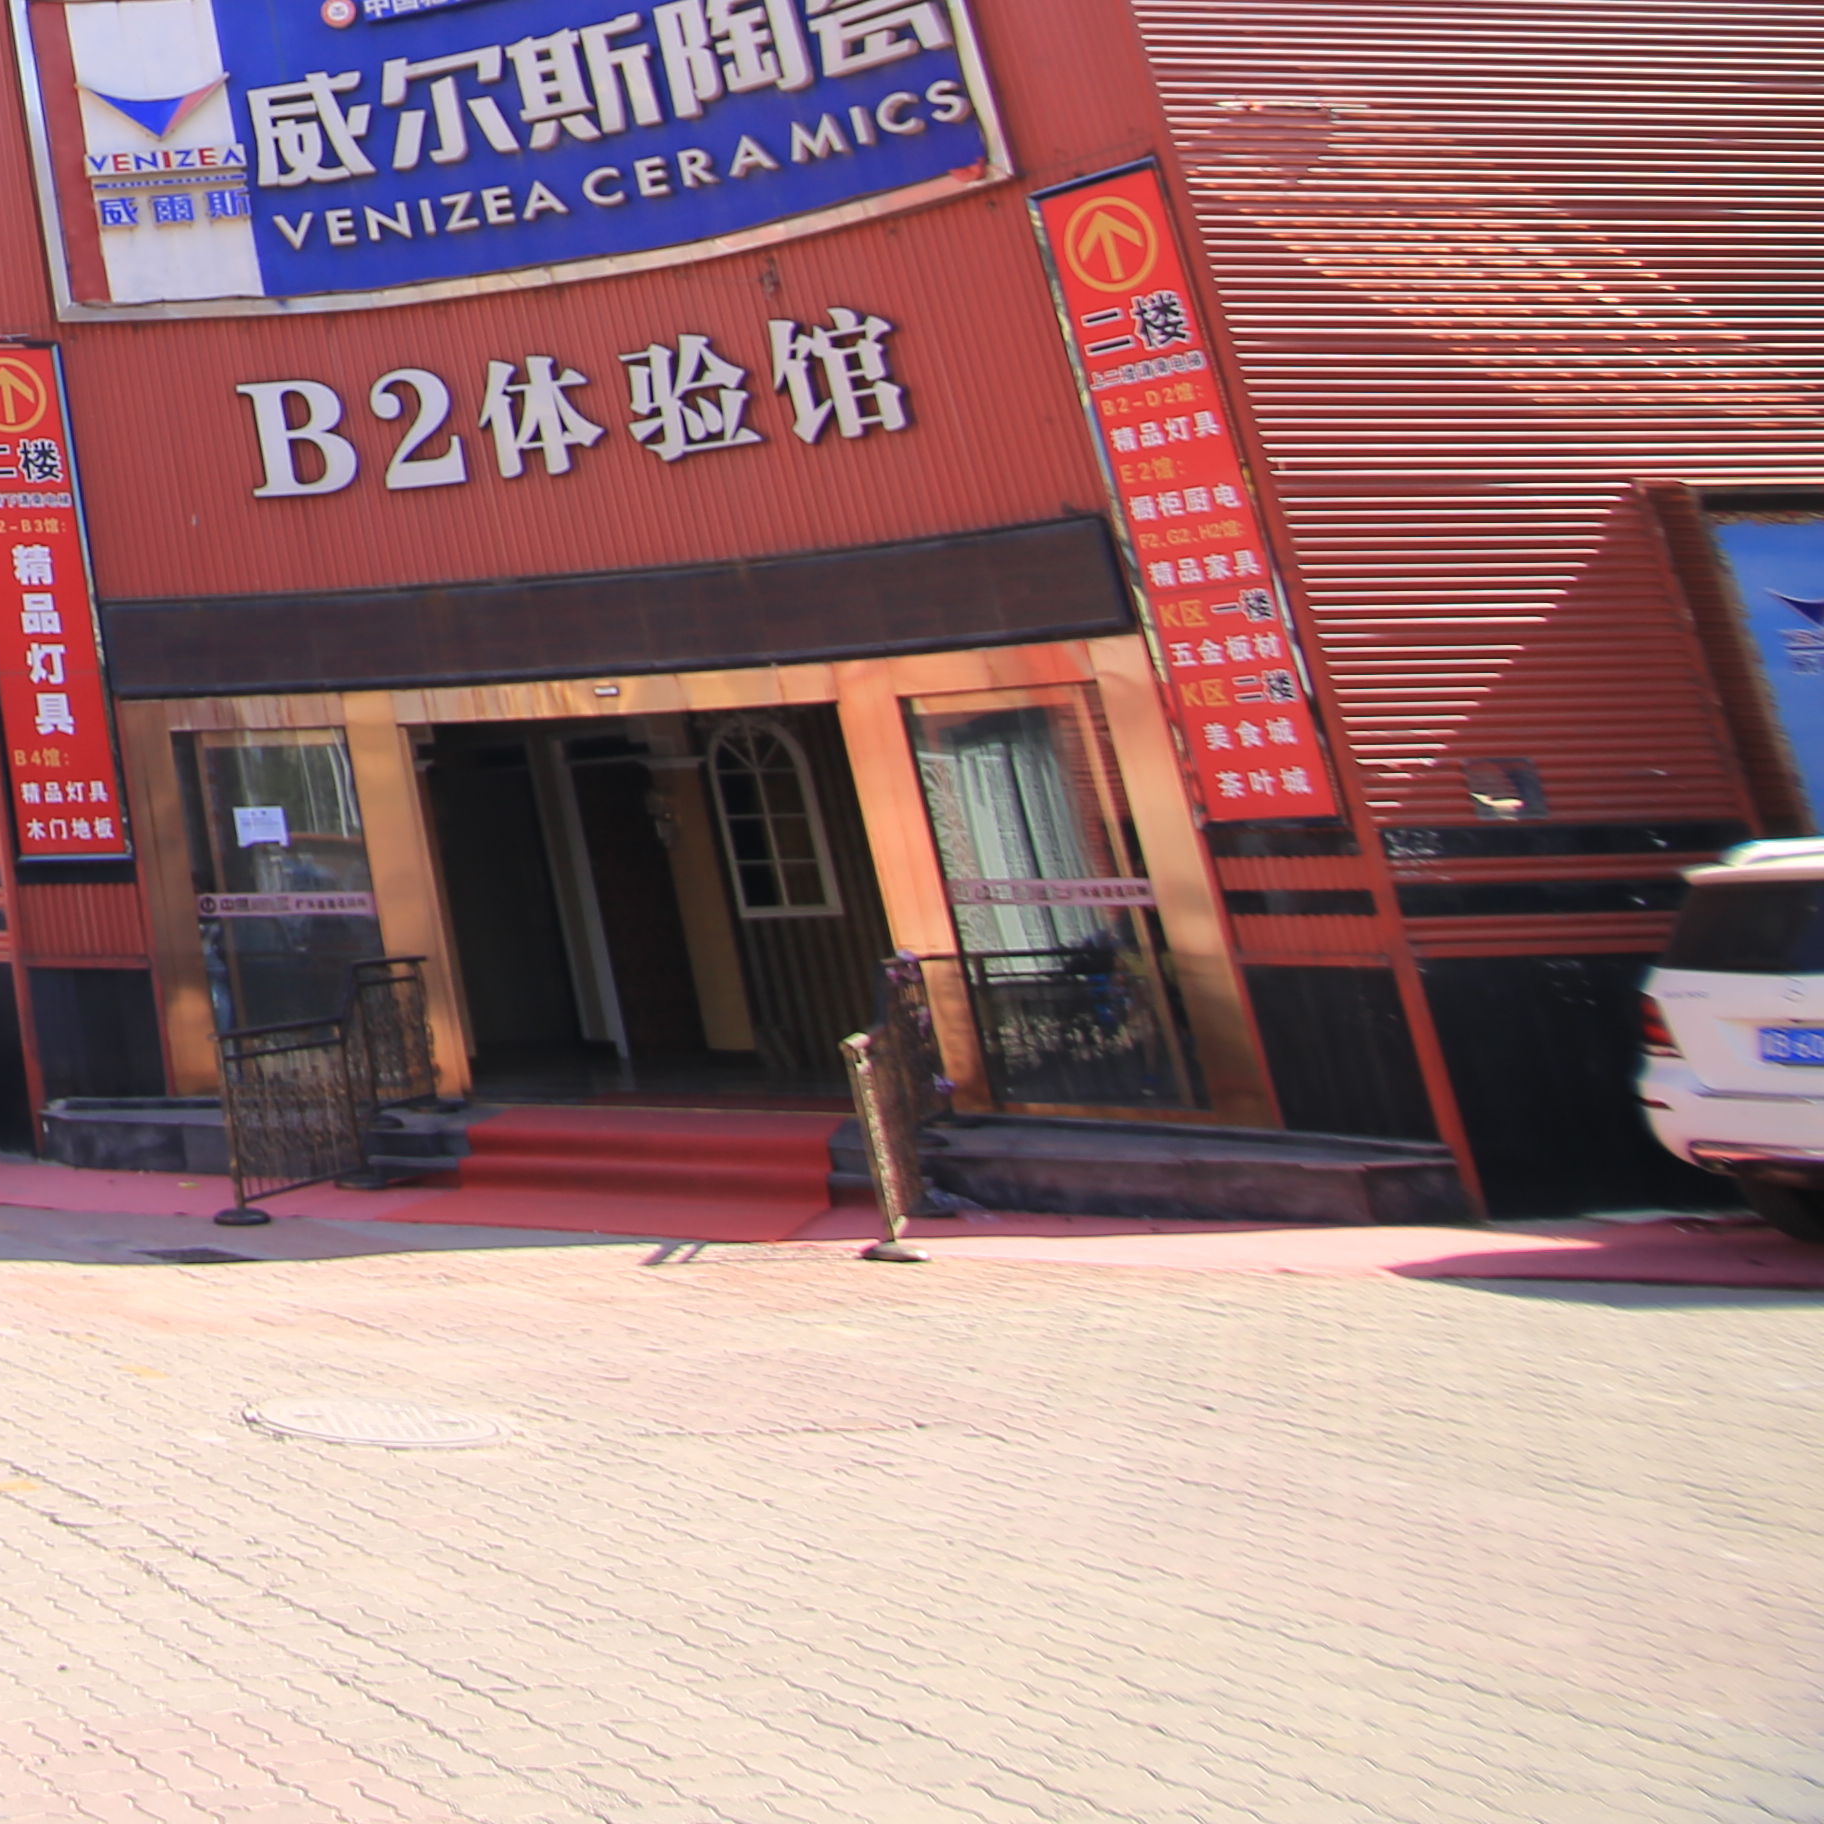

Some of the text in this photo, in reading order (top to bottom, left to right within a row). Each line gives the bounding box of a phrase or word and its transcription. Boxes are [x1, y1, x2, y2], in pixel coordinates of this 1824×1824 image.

[88, 147, 245, 172] VENIZEA
[272, 79, 973, 252] VENIZEA CERAMICS
[98, 187, 254, 227] 威爾斯
[1082, 289, 1193, 357] 二楼
[234, 307, 912, 500] B2体验馆
[1108, 410, 1222, 454] 精品灯具
[1128, 481, 1243, 523] 橱柜厨电
[1147, 549, 1262, 588] 精品家具
[1161, 587, 1277, 629] K区 一楼
[11, 544, 76, 736] 精品灯具
[1168, 631, 1283, 669] 五金板材
[1179, 668, 1301, 709] K区 二楼
[1202, 716, 1300, 752] 美食城
[20, 780, 109, 804] 精品灯具
[1215, 766, 1314, 800] 茶叶城
[26, 816, 115, 840] 木门地板
